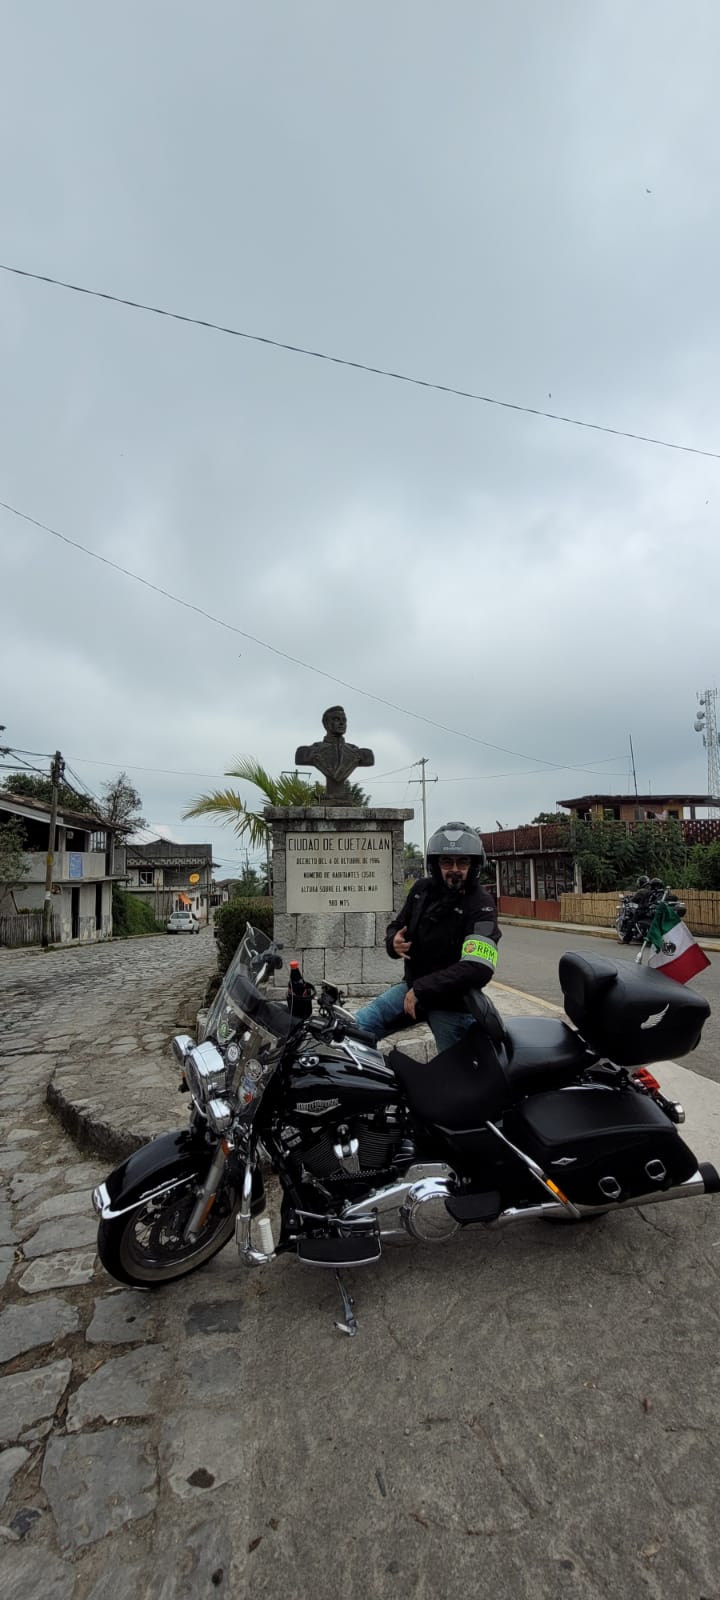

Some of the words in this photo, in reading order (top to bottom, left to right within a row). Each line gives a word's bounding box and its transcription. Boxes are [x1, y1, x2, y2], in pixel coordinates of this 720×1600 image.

[288, 838, 320, 851] CIUDAD
[323, 838, 335, 851] DE
[338, 838, 390, 851] CUETZALAN
[477, 944, 495, 959] RRM
